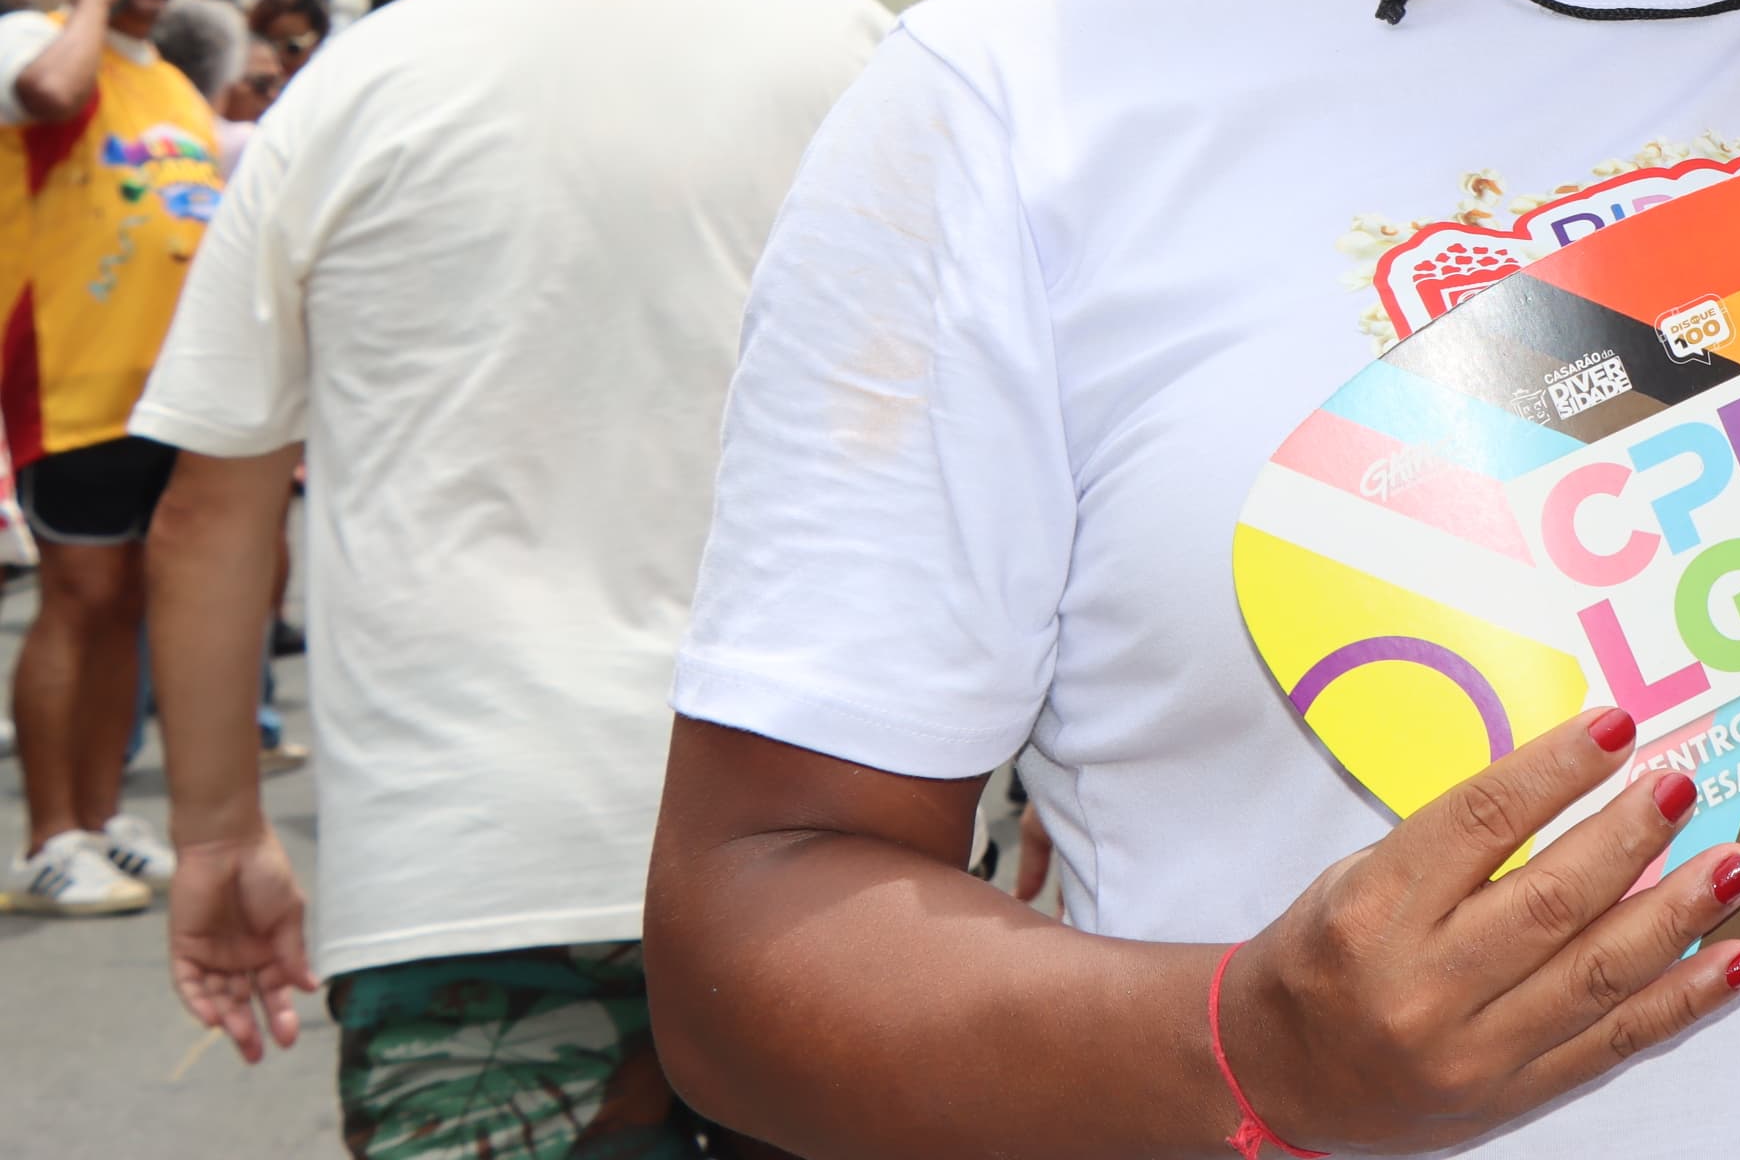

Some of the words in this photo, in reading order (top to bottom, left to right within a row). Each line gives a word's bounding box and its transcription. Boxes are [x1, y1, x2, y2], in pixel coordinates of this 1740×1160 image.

[1670, 307, 1717, 334] DISQUE
[1674, 319, 1721, 350] 100
[1544, 352, 1601, 385] CASARÃO
[1601, 349, 1615, 360] da
[1549, 357, 1627, 404] DIVER
[1557, 378, 1633, 419] SIDADE
